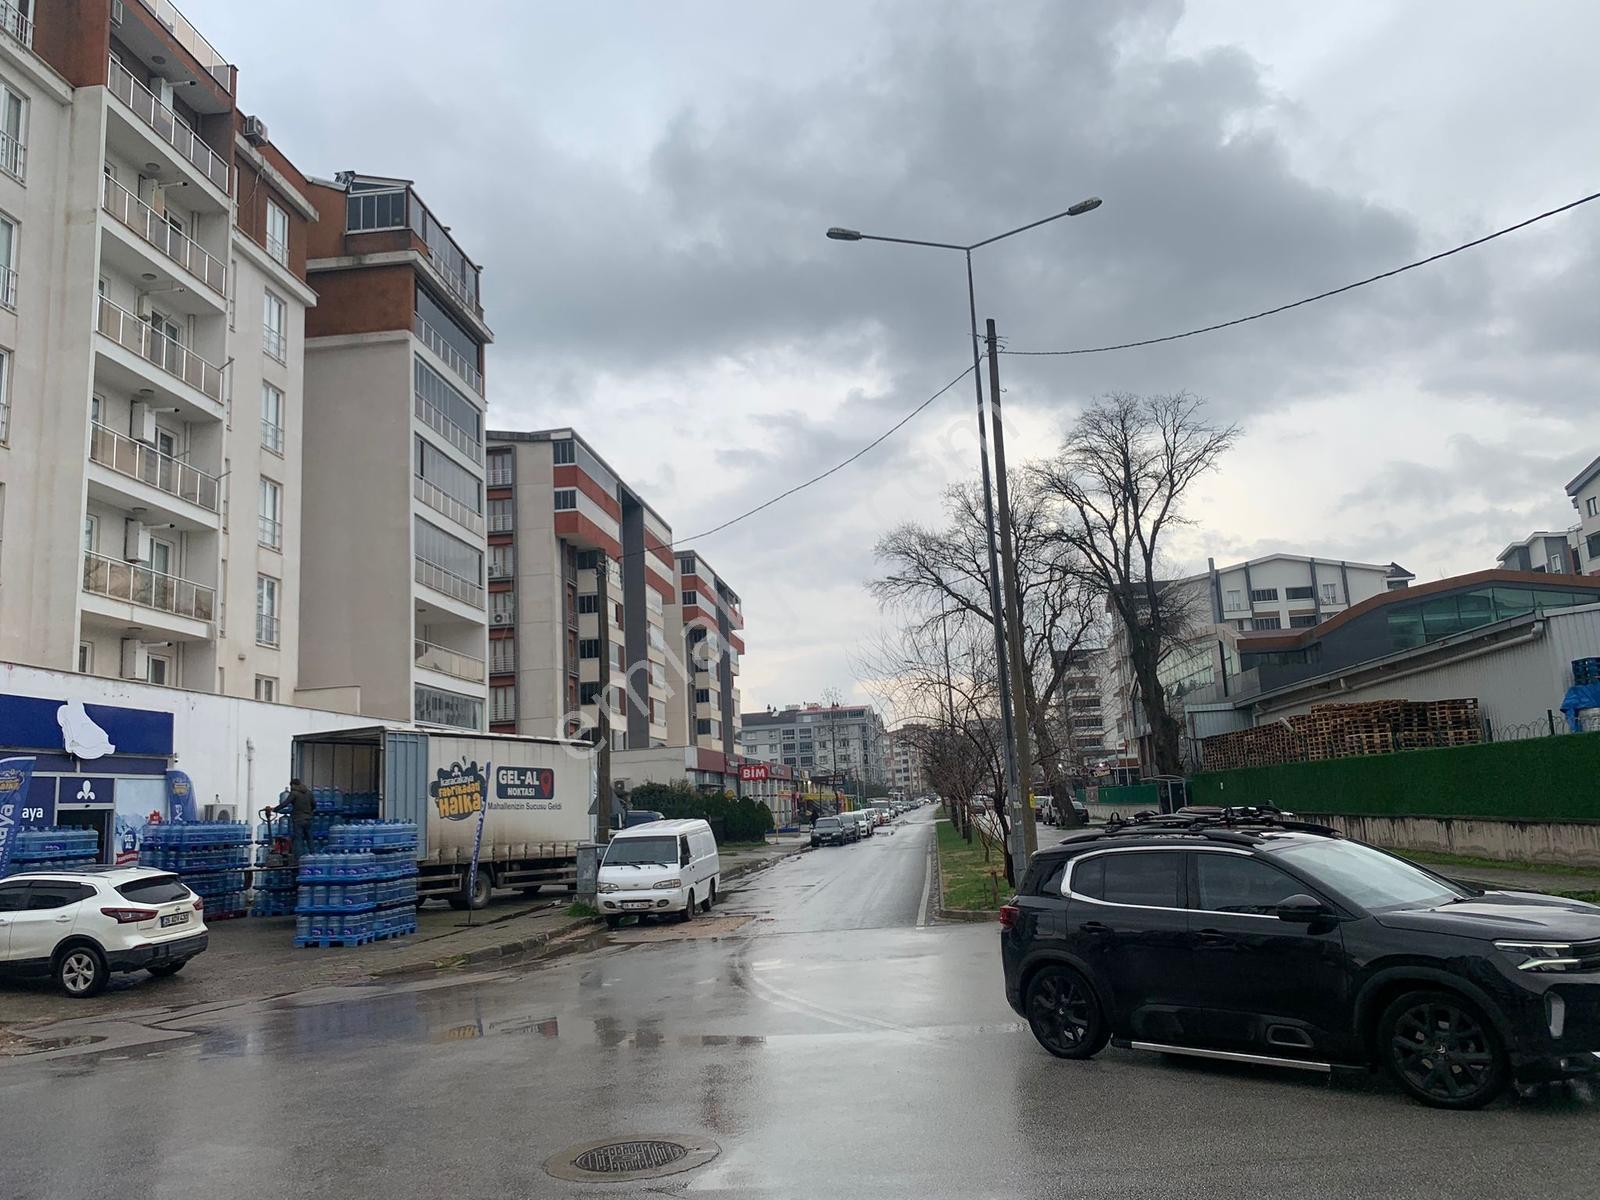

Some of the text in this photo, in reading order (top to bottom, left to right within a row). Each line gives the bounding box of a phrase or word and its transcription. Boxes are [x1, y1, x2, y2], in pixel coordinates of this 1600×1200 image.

[499, 770, 540, 785] GEL-AL
[743, 766, 765, 778] BİM
[507, 787, 535, 796] NOKTASI
[439, 792, 481, 817] Halka
[488, 802, 562, 810] Mahallenizin Sucusu Geldi
